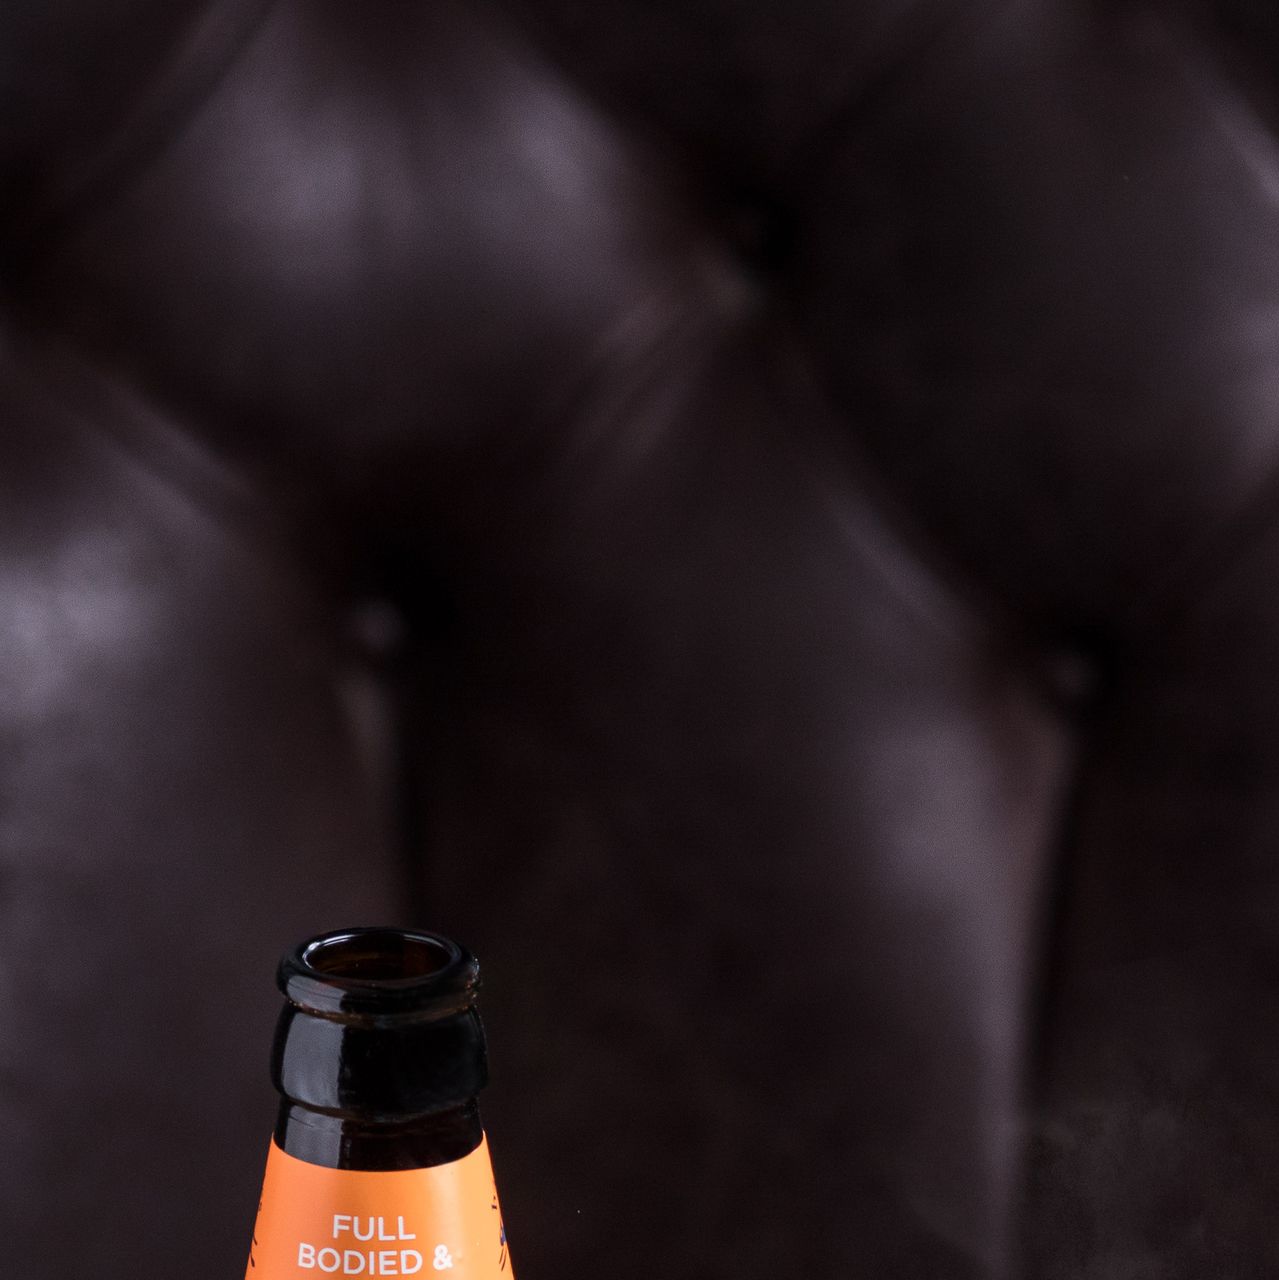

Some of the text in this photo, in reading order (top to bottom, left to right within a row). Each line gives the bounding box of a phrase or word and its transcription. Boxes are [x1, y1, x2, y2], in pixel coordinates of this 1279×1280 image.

[332, 1214, 416, 1241] FULL
[297, 1243, 453, 1275] BODIED &
